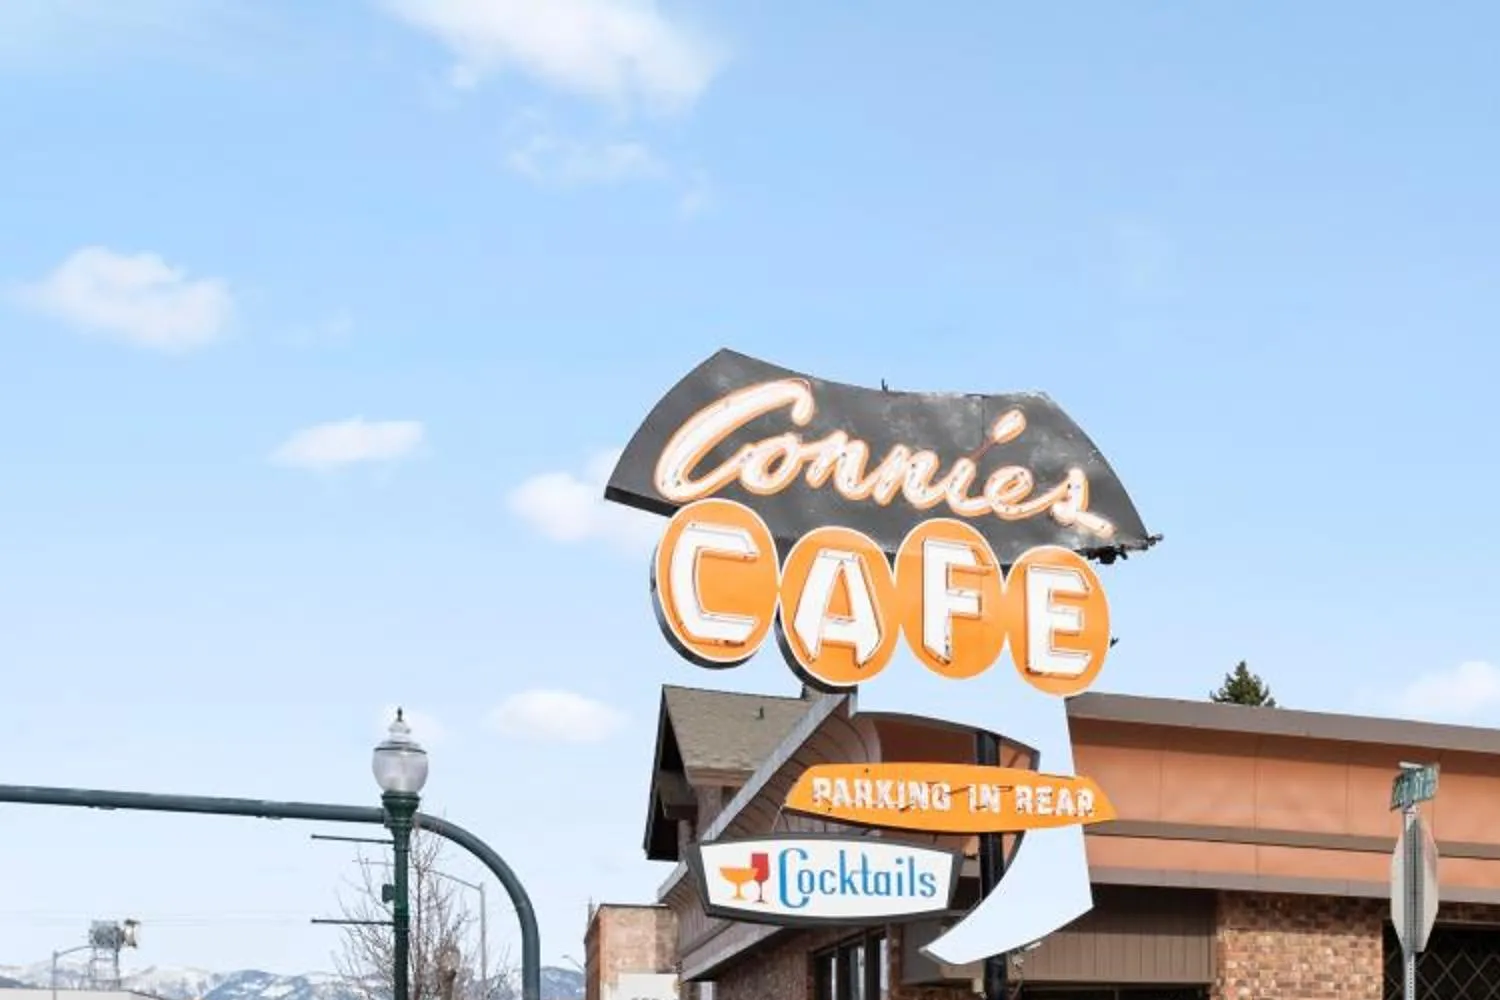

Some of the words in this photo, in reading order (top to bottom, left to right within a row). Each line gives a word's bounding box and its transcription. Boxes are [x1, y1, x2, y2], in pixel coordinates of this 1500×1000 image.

[668, 521, 1093, 678] CAFE
[811, 777, 952, 811] PARKING
[967, 783, 1001, 814] IN
[1015, 785, 1095, 818] REAR
[778, 847, 937, 909] Cocktails
